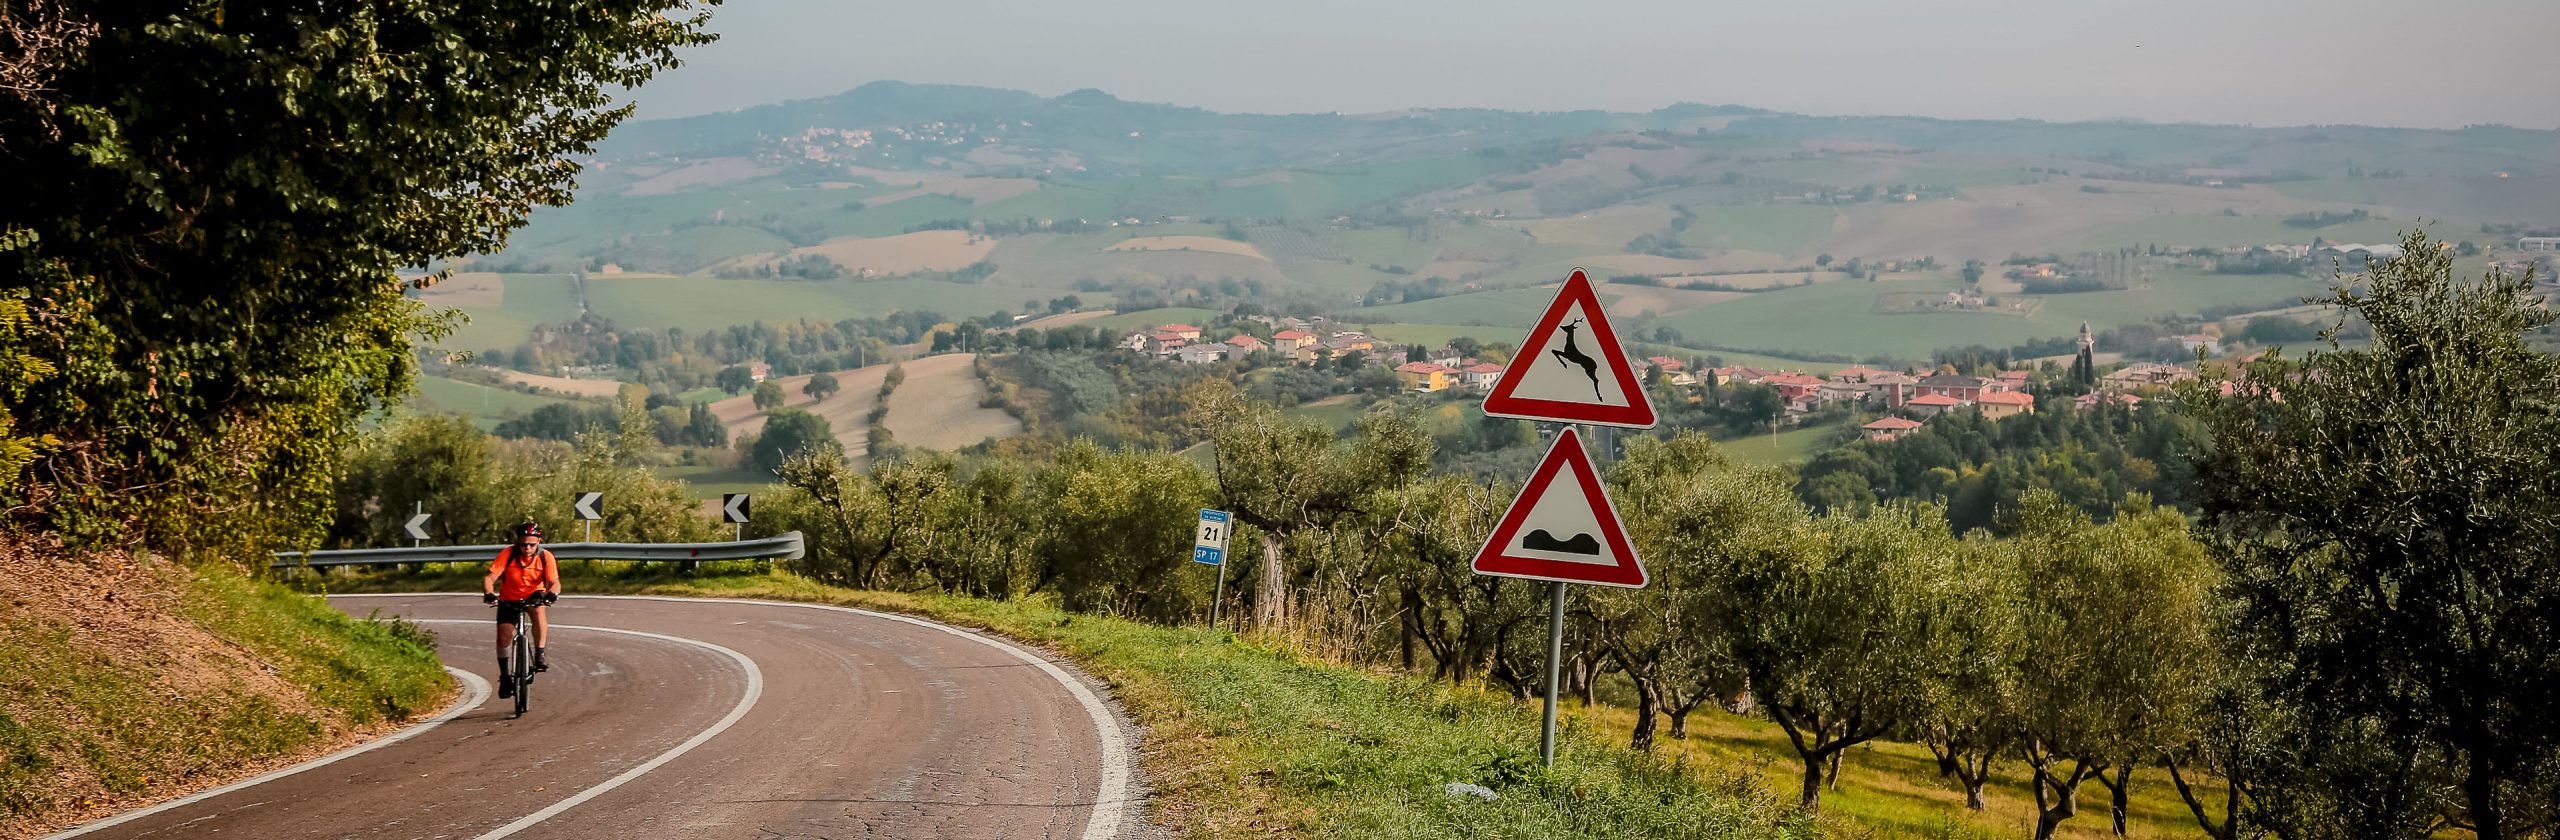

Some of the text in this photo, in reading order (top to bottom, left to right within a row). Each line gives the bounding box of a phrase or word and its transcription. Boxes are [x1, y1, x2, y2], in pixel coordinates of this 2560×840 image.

[1204, 527, 1218, 541] 21
[1196, 550, 1218, 561] SP 17
